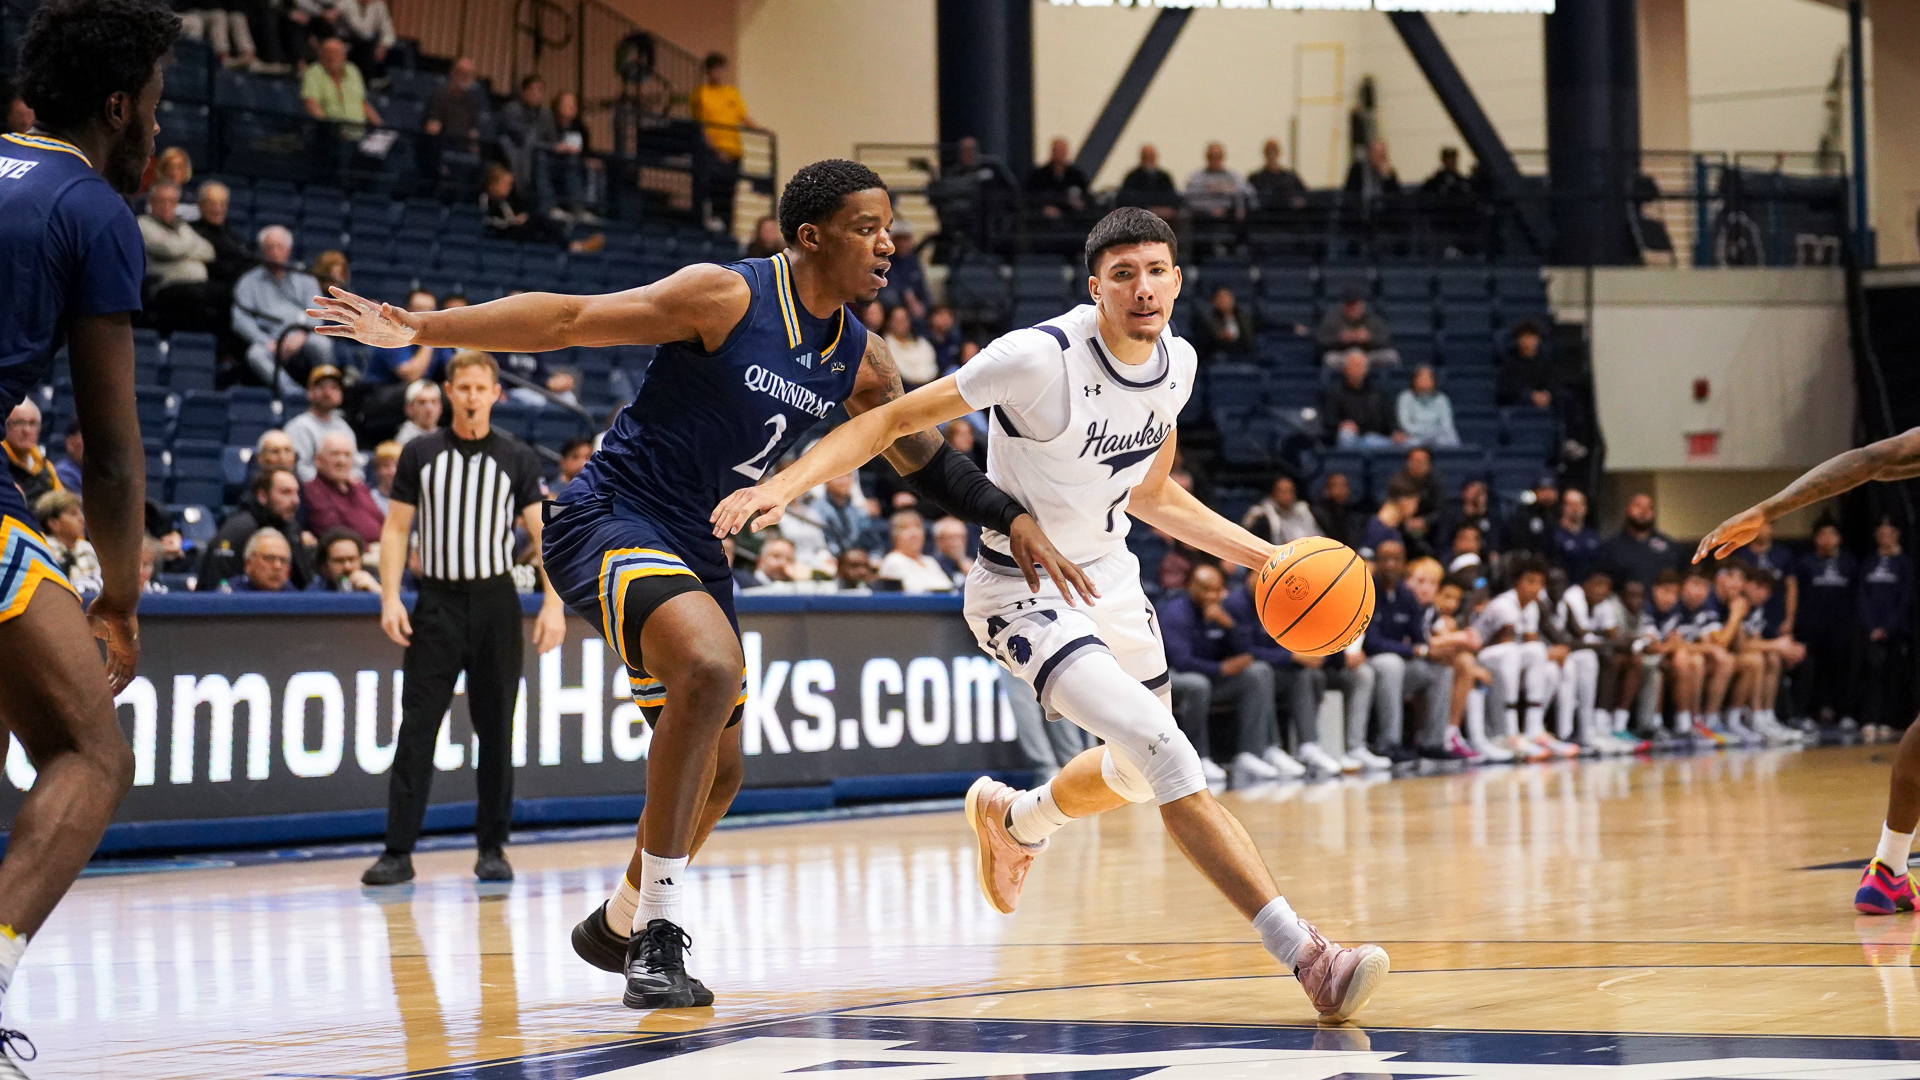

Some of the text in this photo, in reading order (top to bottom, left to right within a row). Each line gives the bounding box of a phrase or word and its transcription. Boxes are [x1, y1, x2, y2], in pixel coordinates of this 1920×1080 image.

[744, 364, 836, 420] QUINNIPIAC
[731, 413, 787, 481] 2
[1077, 410, 1172, 460] Hawks
